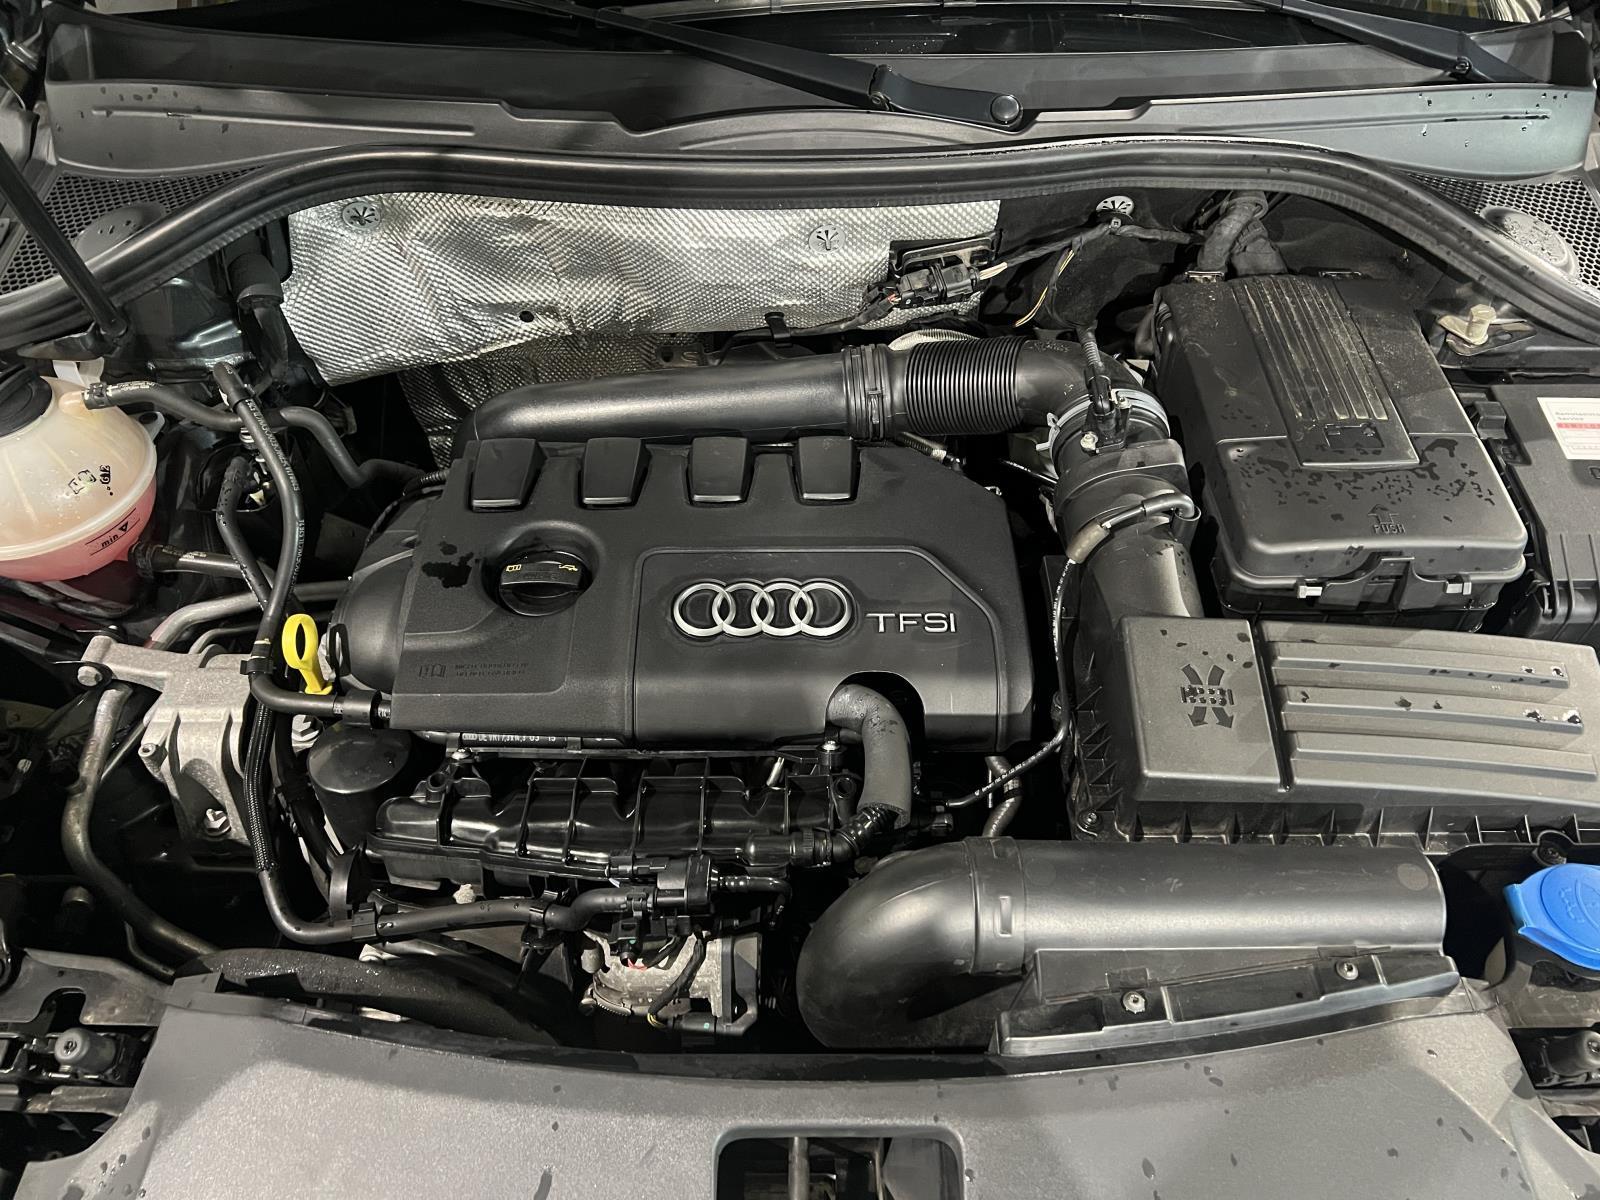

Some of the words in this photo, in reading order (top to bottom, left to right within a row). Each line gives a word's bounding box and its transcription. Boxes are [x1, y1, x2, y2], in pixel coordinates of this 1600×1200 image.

[1373, 523, 1406, 534] PUSH
[100, 533, 119, 548] min
[865, 612, 956, 633] TFSI
